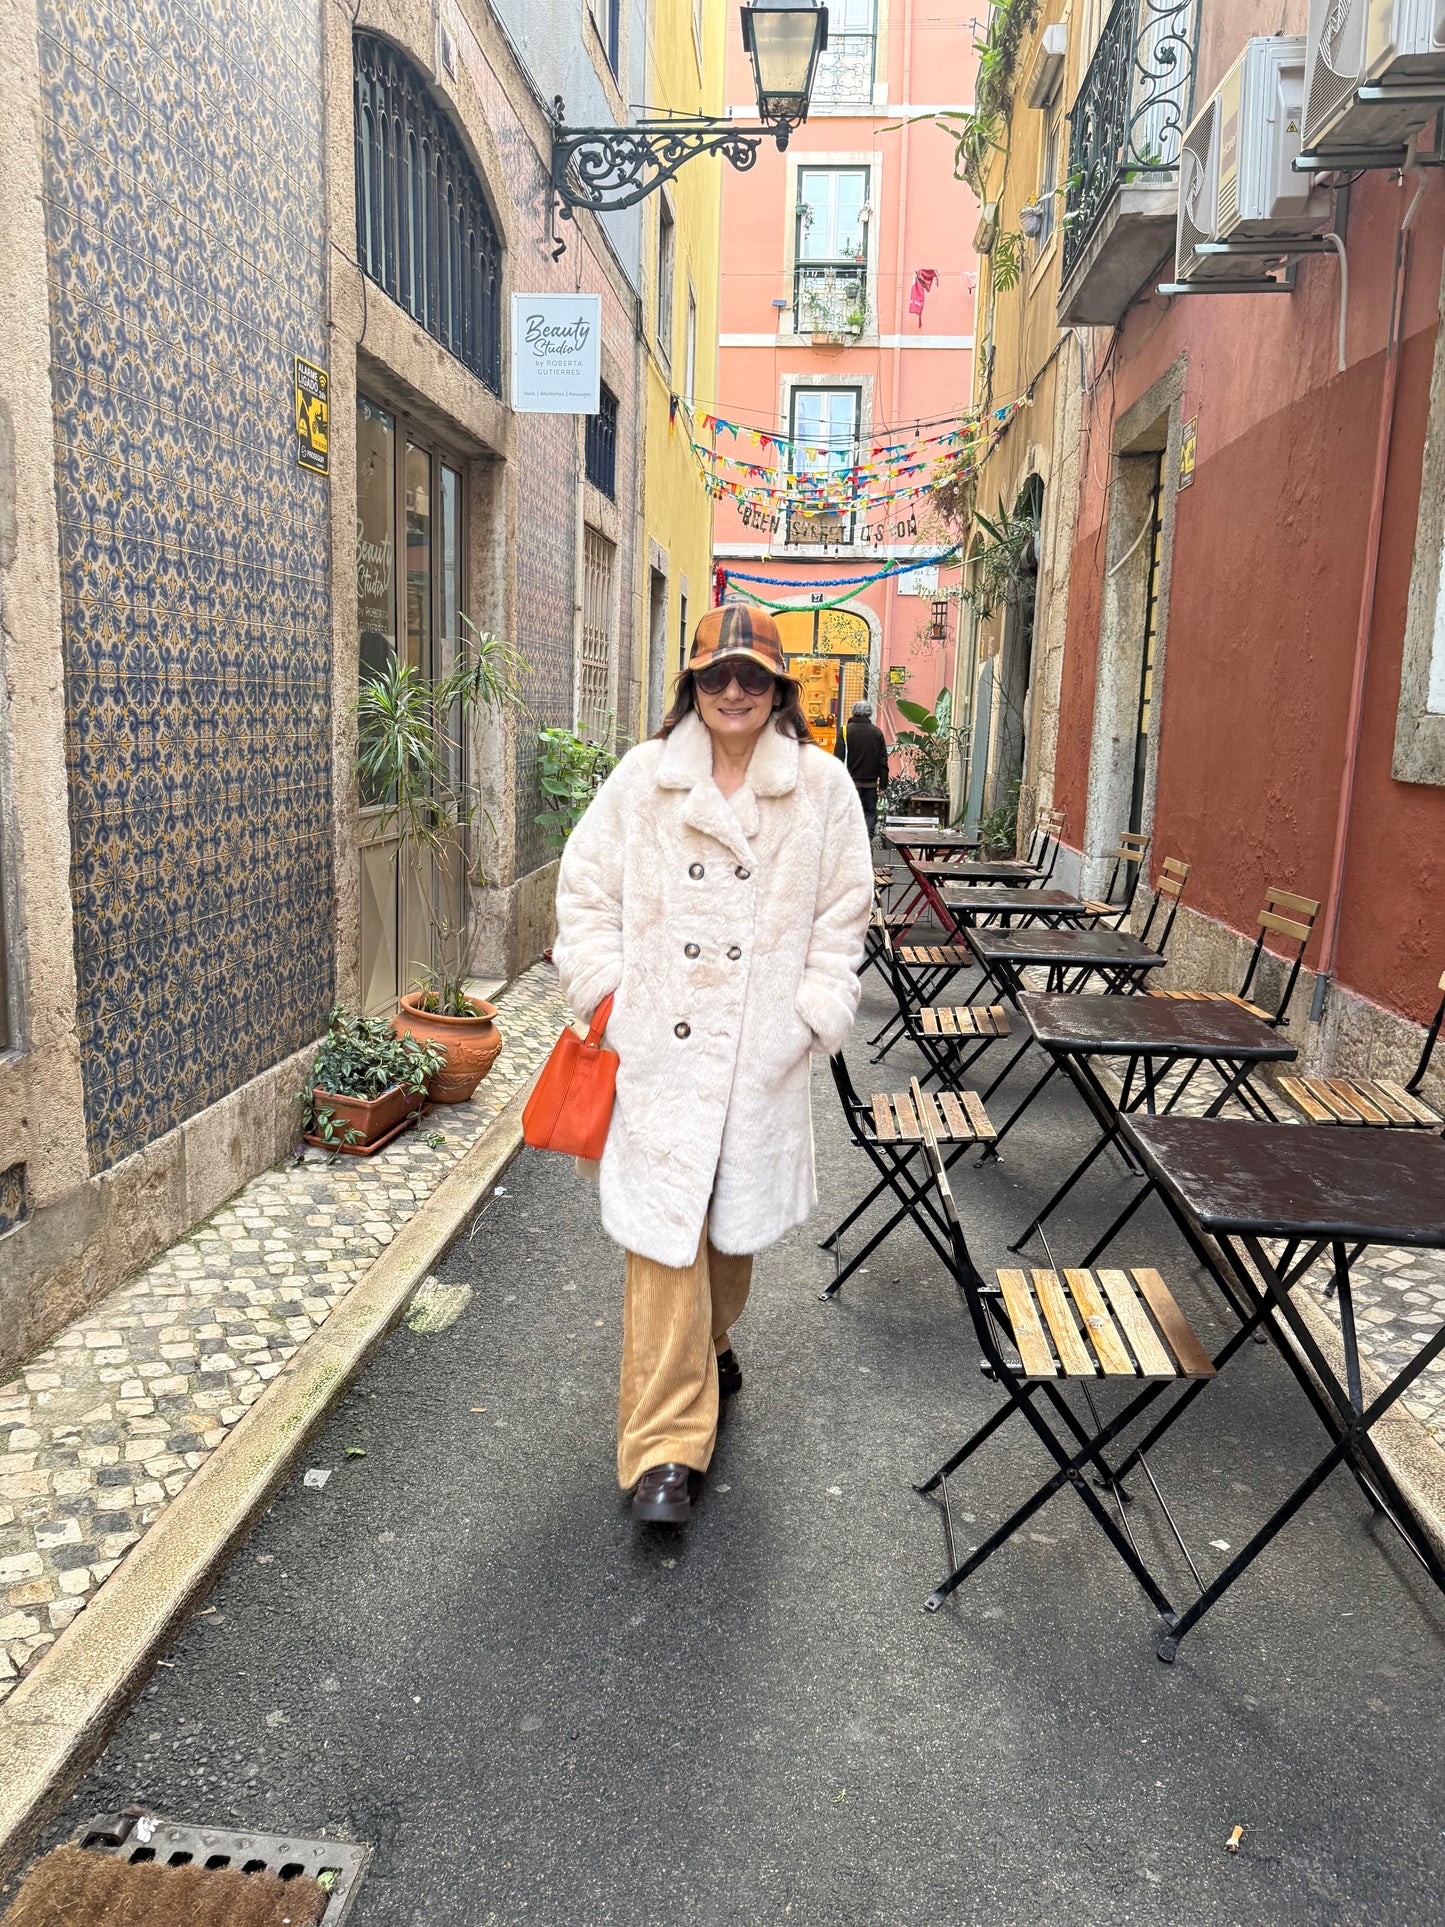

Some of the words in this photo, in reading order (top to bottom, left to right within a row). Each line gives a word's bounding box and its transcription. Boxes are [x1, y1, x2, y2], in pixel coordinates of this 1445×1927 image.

[525, 314, 590, 350] Beauty
[532, 338, 576, 357] Studio
[298, 362, 318, 382] ALARME
[535, 360, 544, 368] by
[298, 372, 319, 393] LIGADO
[860, 519, 918, 541] LSON
